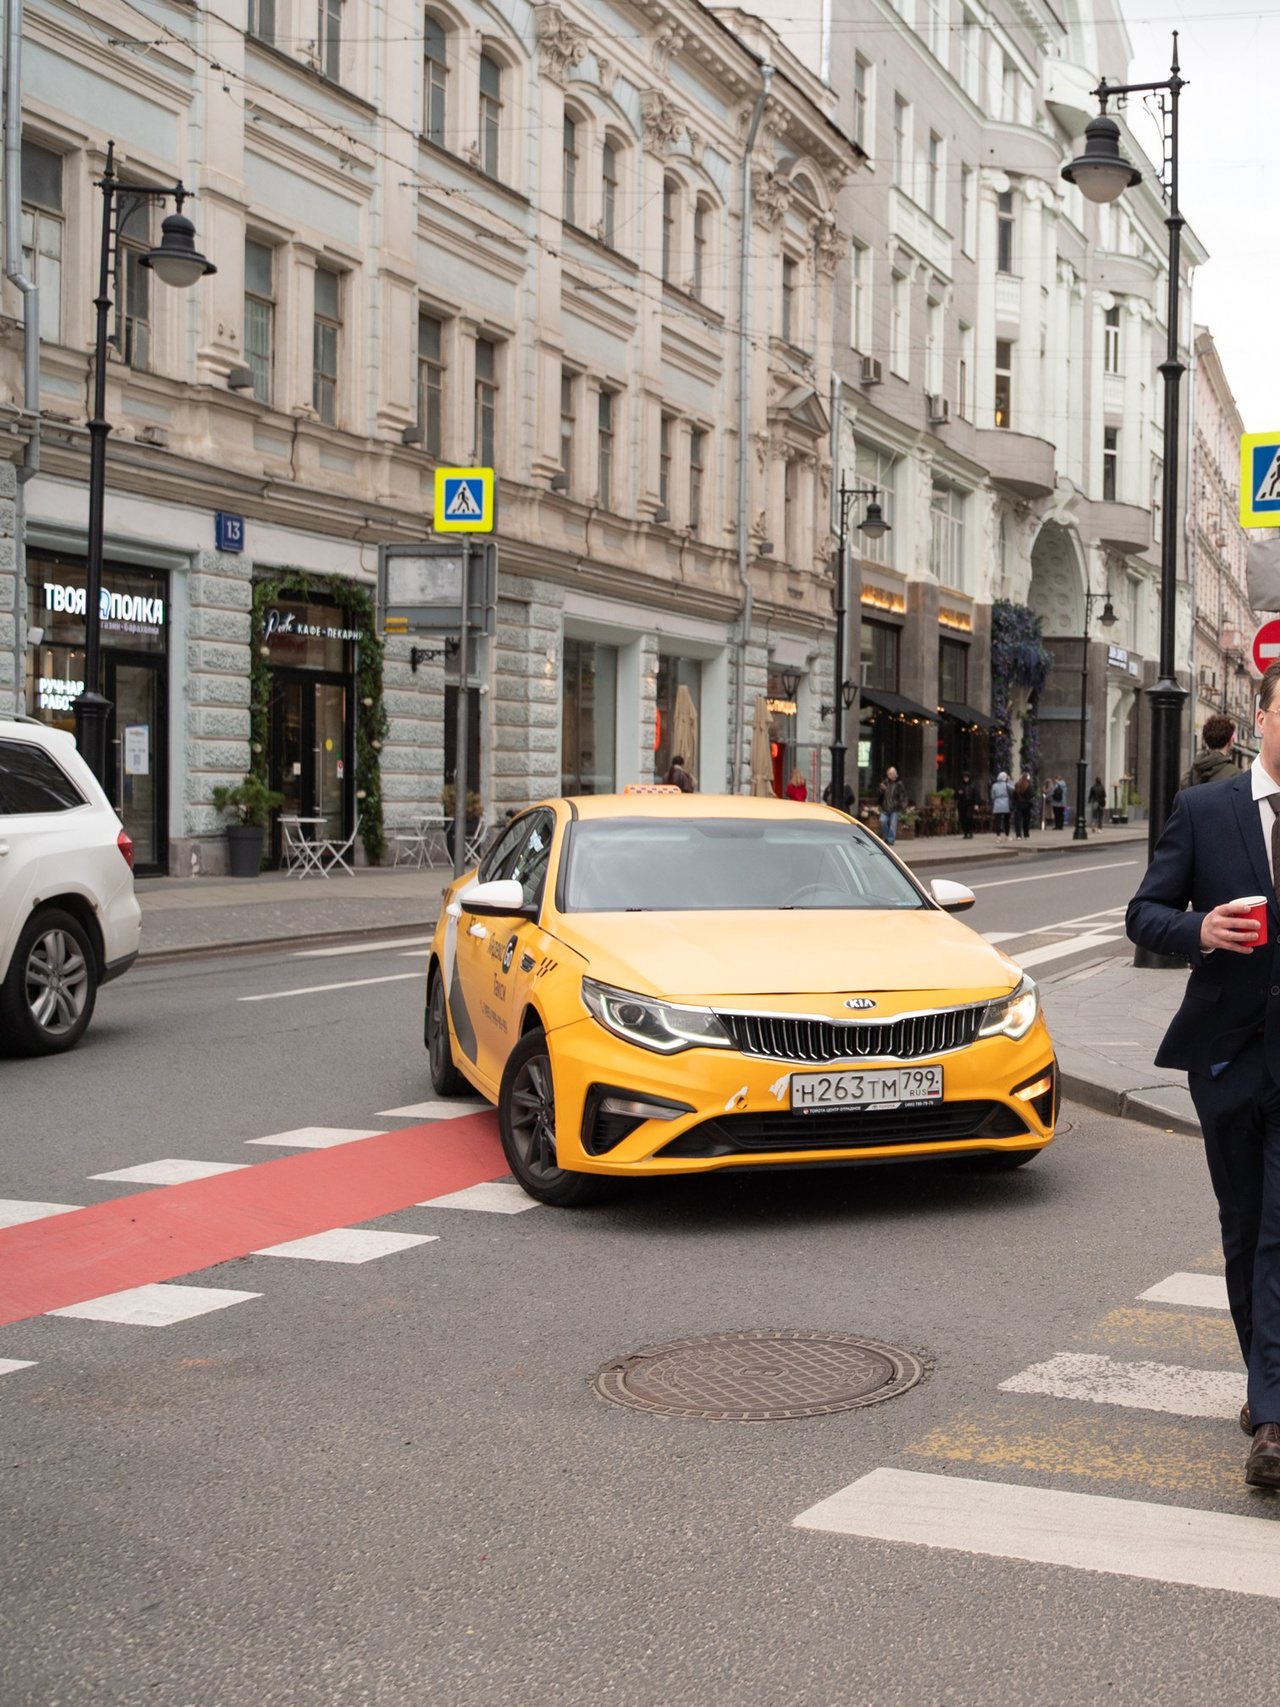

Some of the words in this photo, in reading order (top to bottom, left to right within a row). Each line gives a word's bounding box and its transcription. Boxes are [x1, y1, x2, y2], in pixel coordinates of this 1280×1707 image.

[227, 520, 240, 540] 13
[43, 582, 87, 615] ТВОЯ
[110, 592, 164, 624] ПОЛКА
[850, 999, 874, 1008] KIA
[902, 1070, 936, 1090] 799
[909, 1088, 927, 1097] RUS
